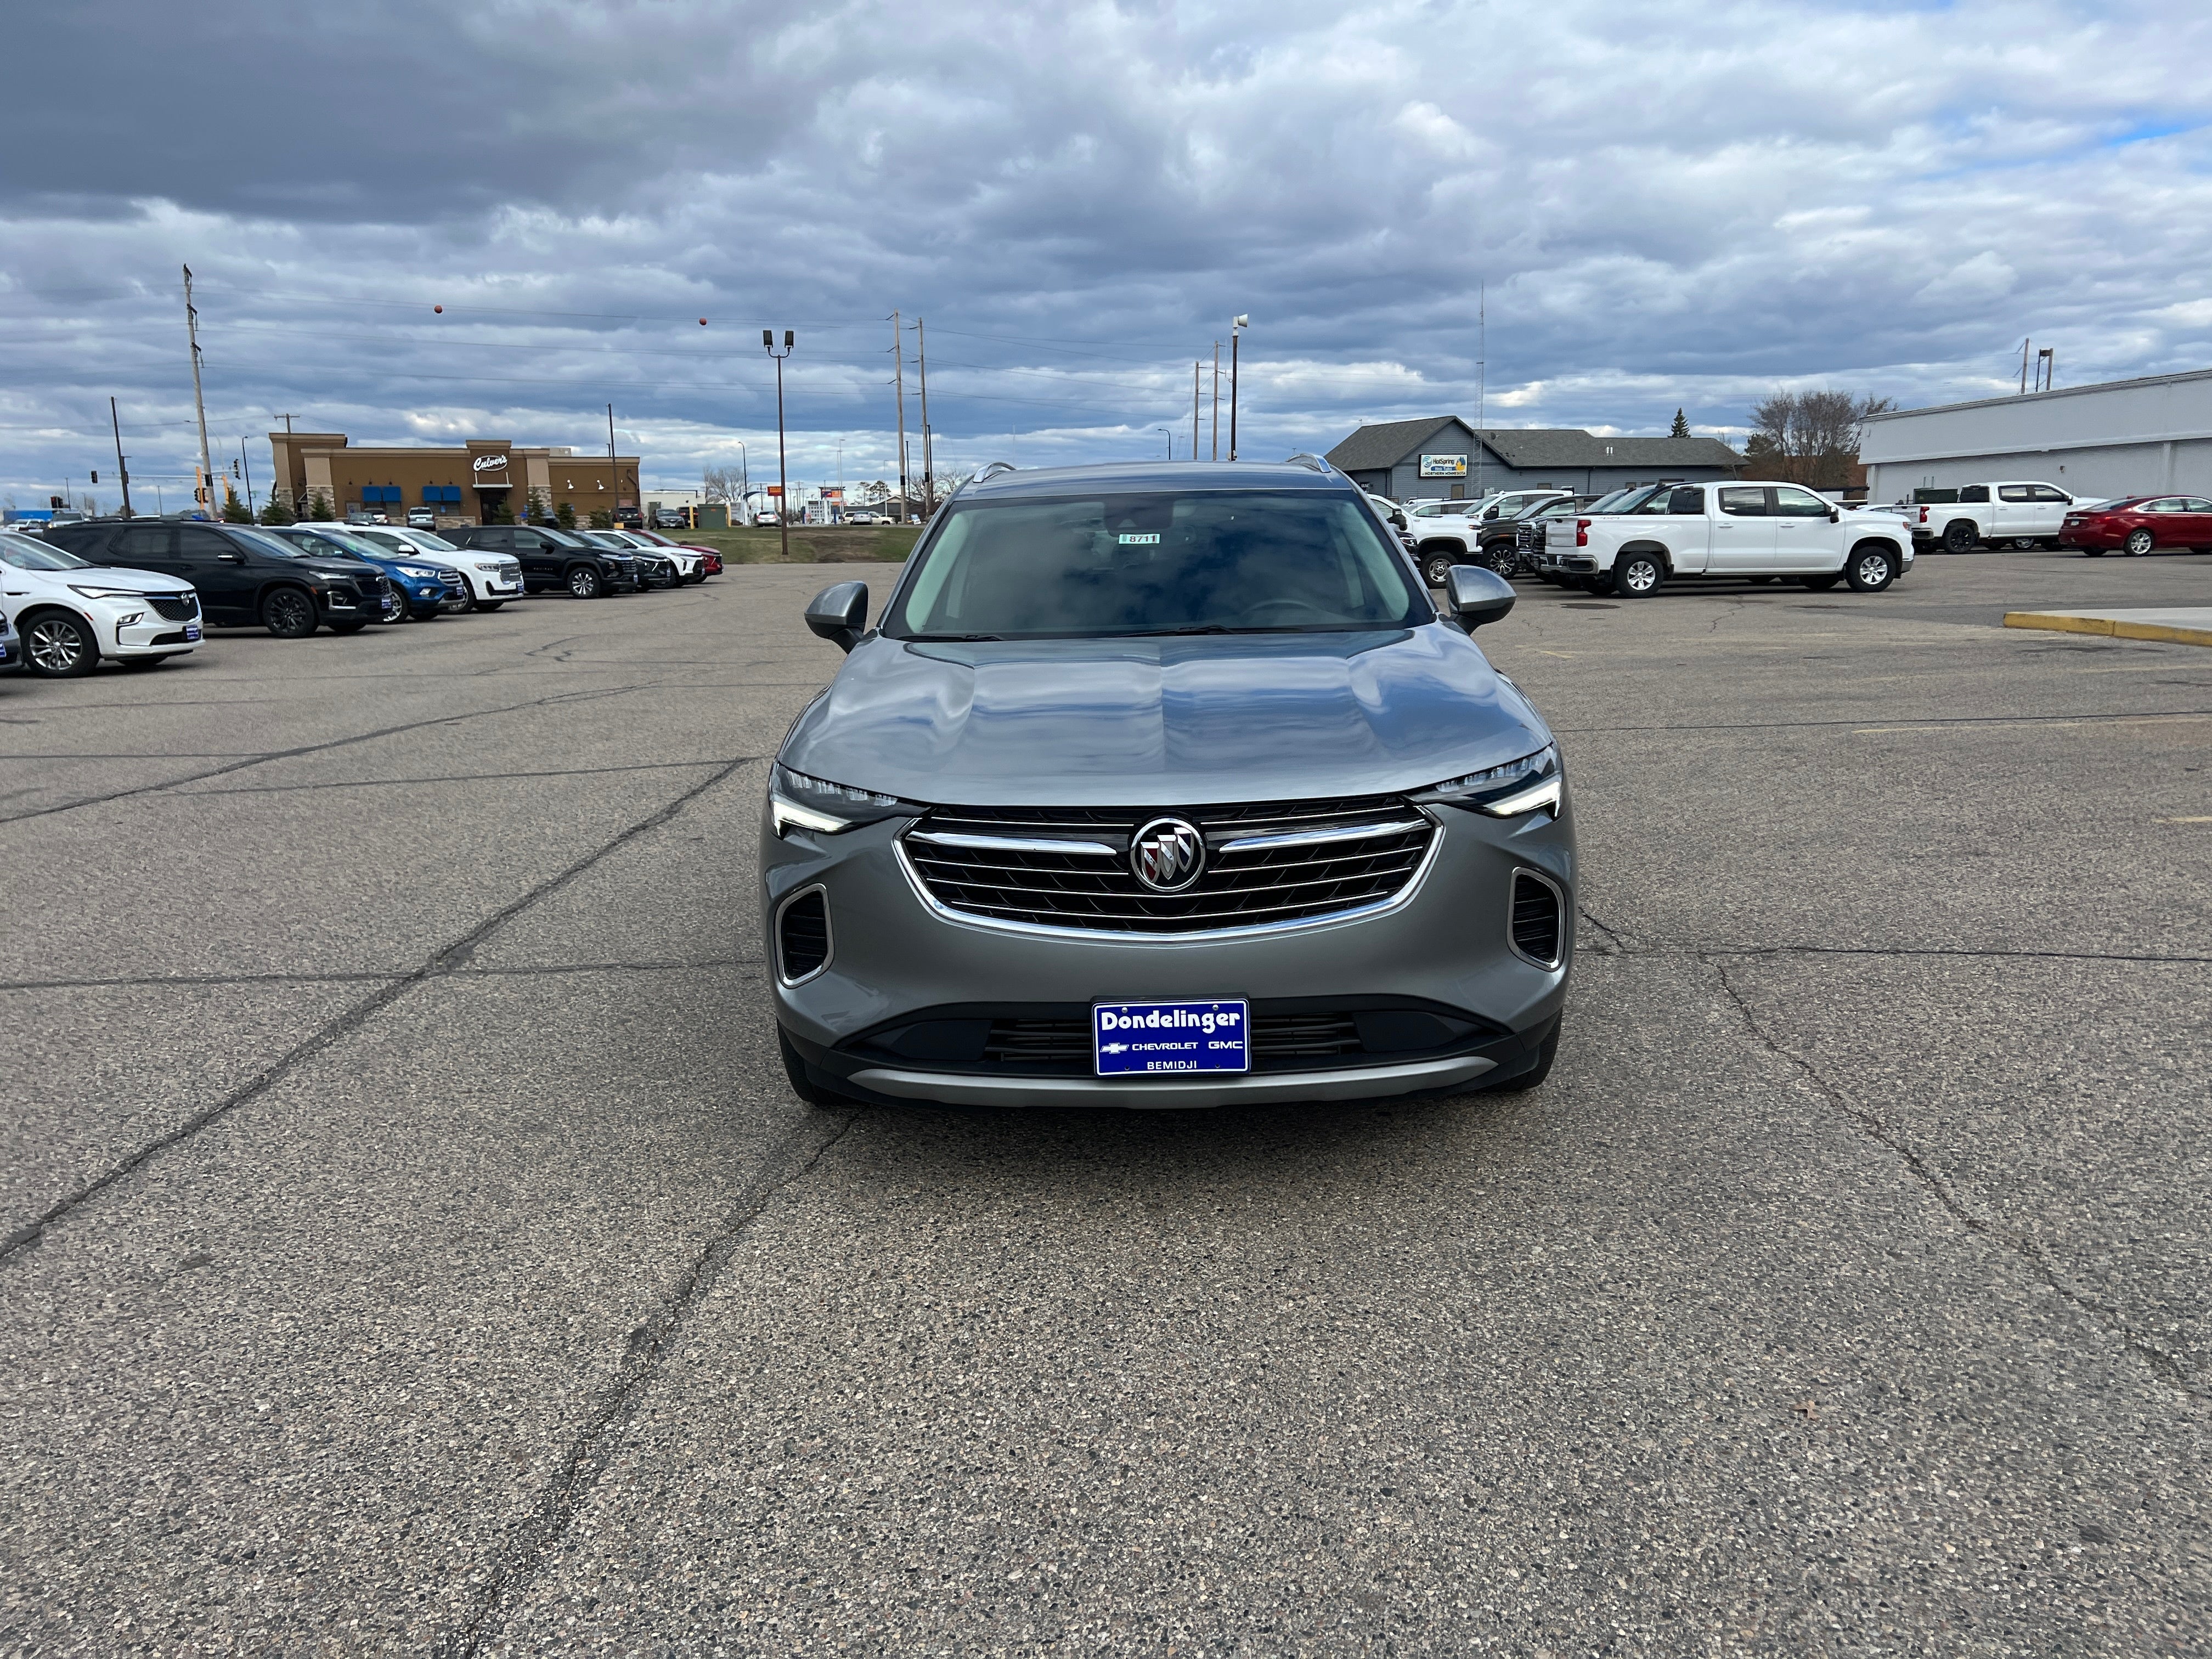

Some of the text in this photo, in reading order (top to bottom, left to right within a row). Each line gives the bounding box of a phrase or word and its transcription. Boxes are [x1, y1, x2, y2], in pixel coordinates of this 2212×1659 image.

[473, 455, 507, 471] Culver's
[1101, 1010, 1240, 1034] Dondelinger
[1132, 1042, 1199, 1051] CHEVROLET
[1147, 1060, 1197, 1070] BEMIDJI
